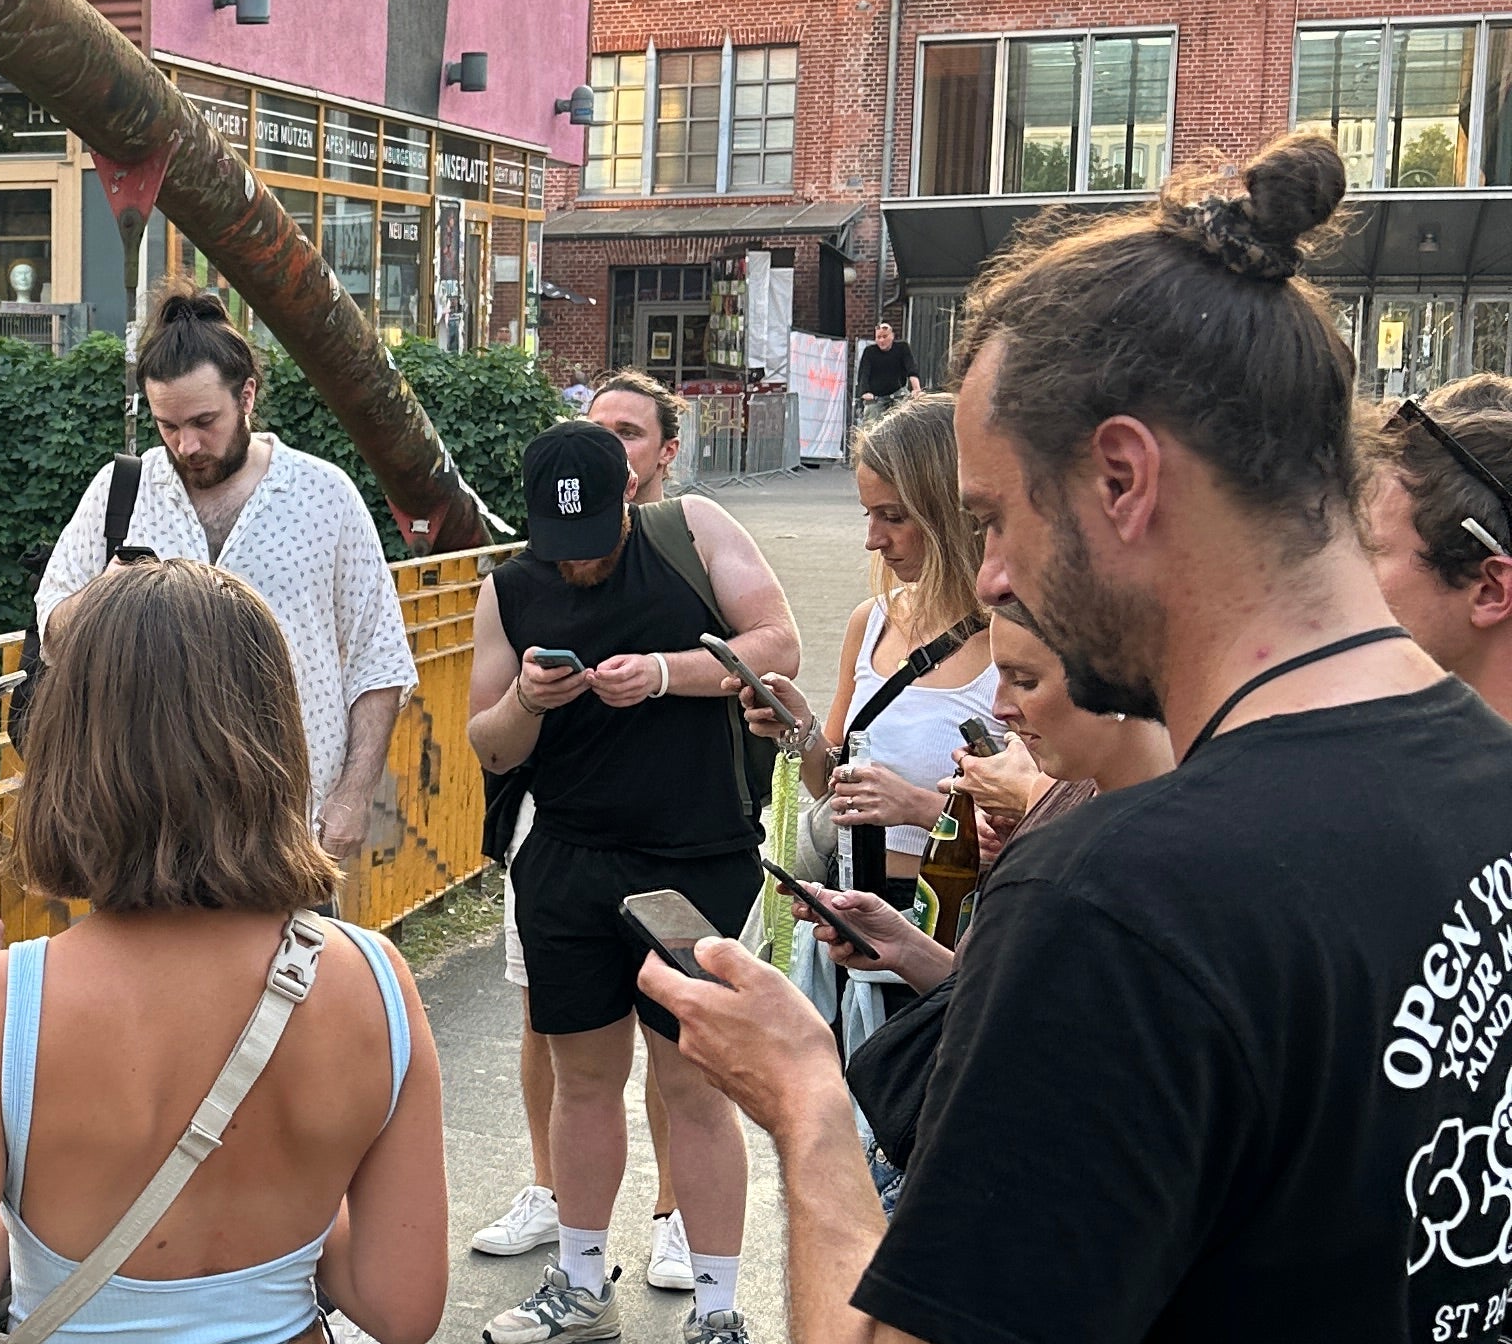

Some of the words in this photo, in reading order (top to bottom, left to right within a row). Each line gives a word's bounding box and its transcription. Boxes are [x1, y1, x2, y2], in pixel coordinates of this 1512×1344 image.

[281, 121, 313, 149] MÜTZEN
[346, 138, 369, 160] HALLO
[558, 501, 582, 515] YOU
[1383, 900, 1481, 1089] OPEN
[1439, 953, 1503, 1080] YOUR
[1466, 994, 1512, 1092] MIND
[1432, 1302, 1479, 1342] ST
